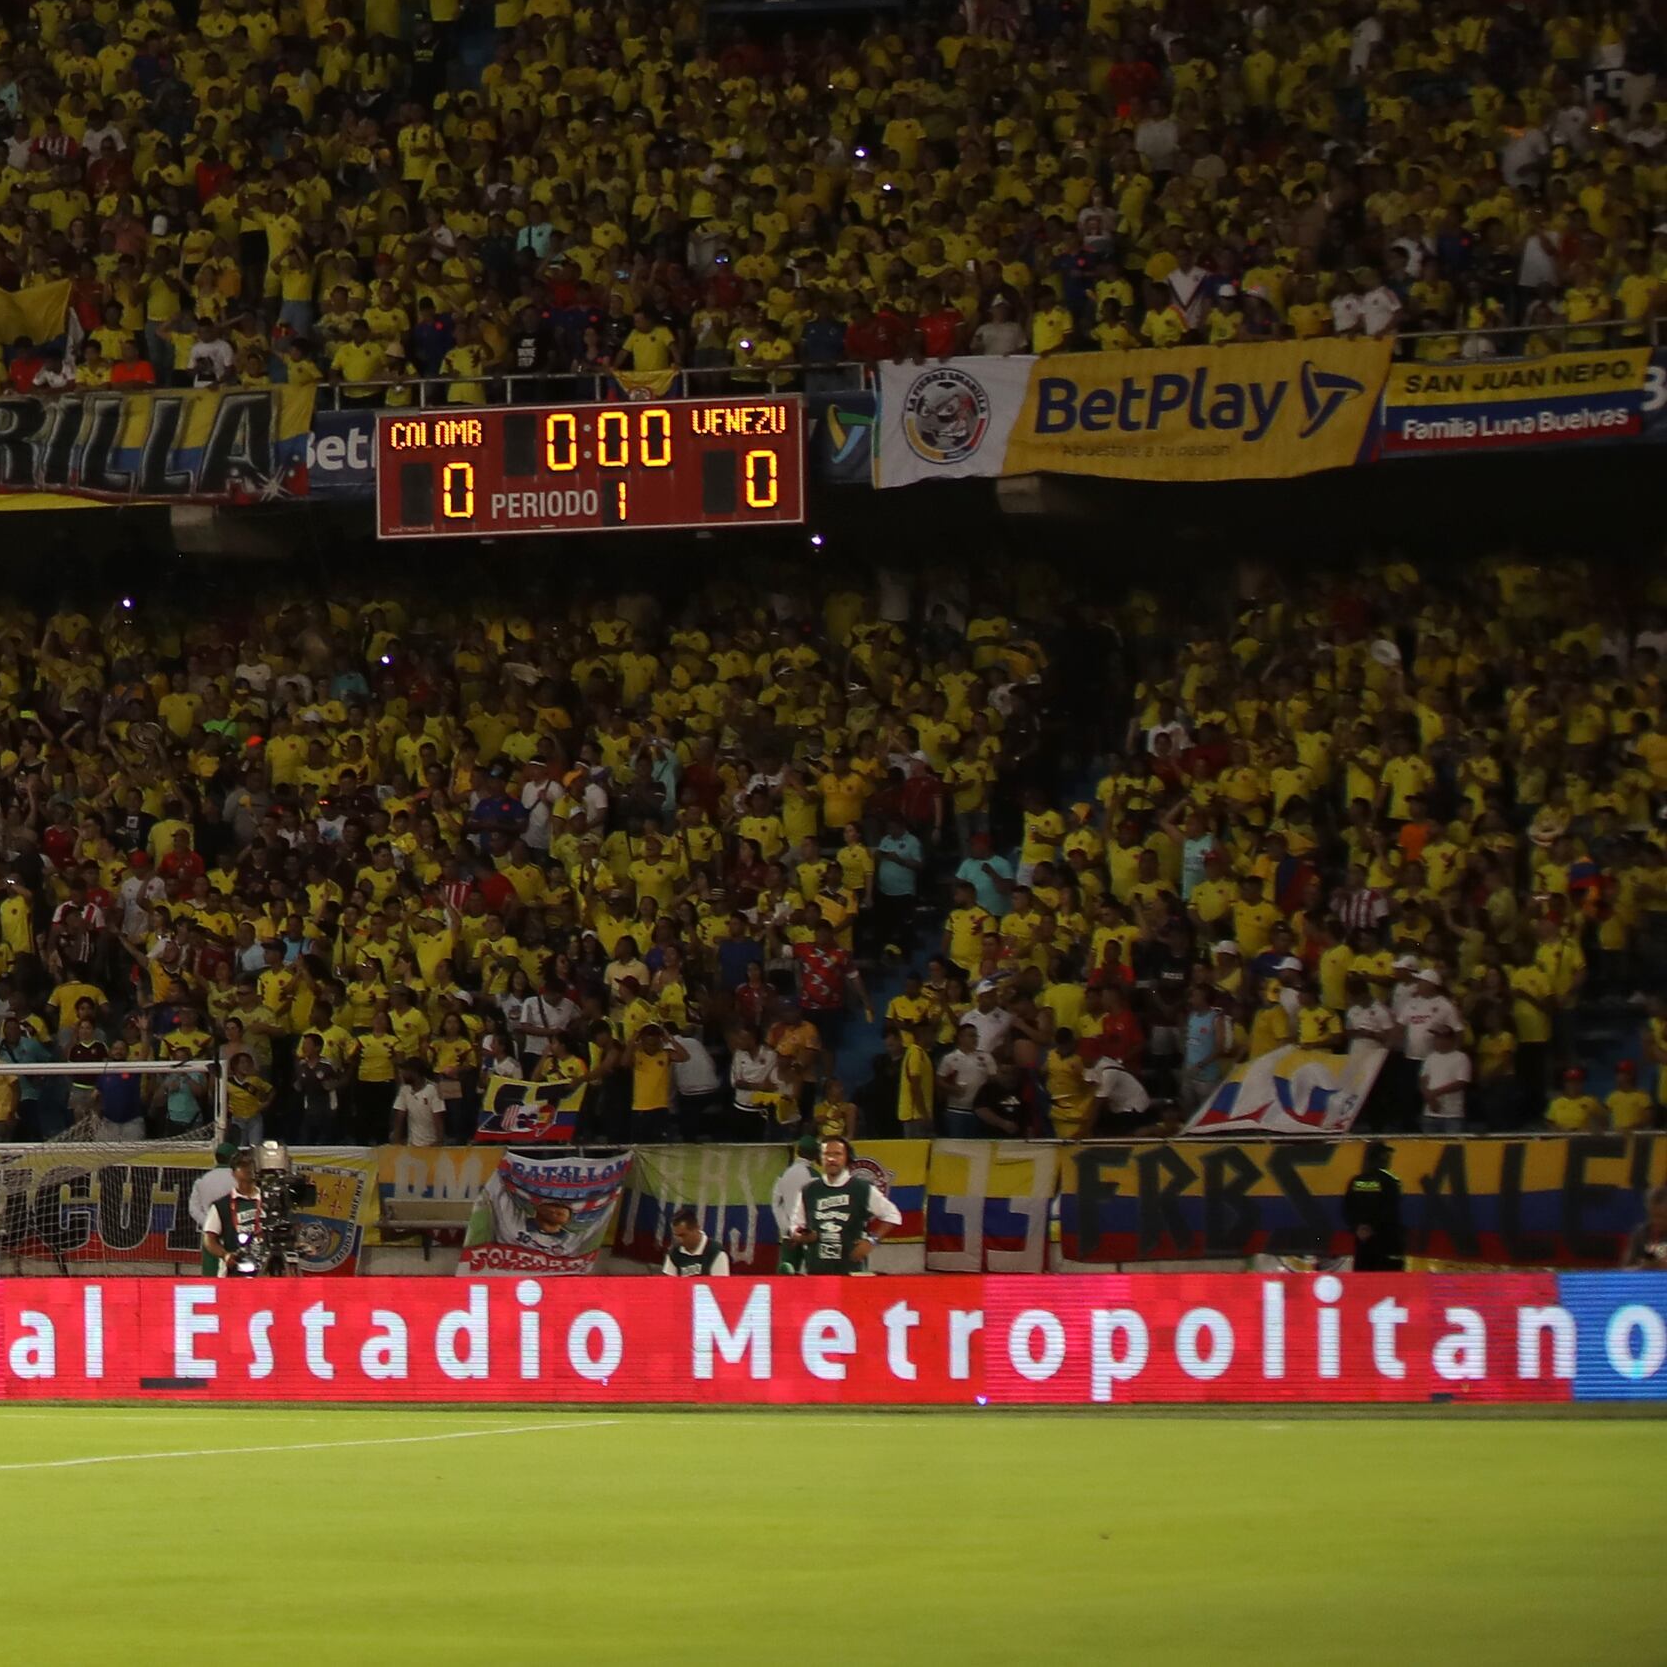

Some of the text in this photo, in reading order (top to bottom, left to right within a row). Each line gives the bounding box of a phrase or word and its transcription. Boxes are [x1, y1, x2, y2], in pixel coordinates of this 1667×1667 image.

[1035, 361, 1289, 441] BetPlay
[1405, 360, 1635, 394] SAN JUAN NEPO.
[690, 405, 788, 436] VENEZU
[1402, 407, 1629, 440] Familia Luna Buelvas
[442, 449, 779, 522] 0 PERIODO 1 0
[9, 1284, 104, 1380] al
[173, 1278, 623, 1381] Estadio
[692, 1276, 1667, 1403] Metropolitano
